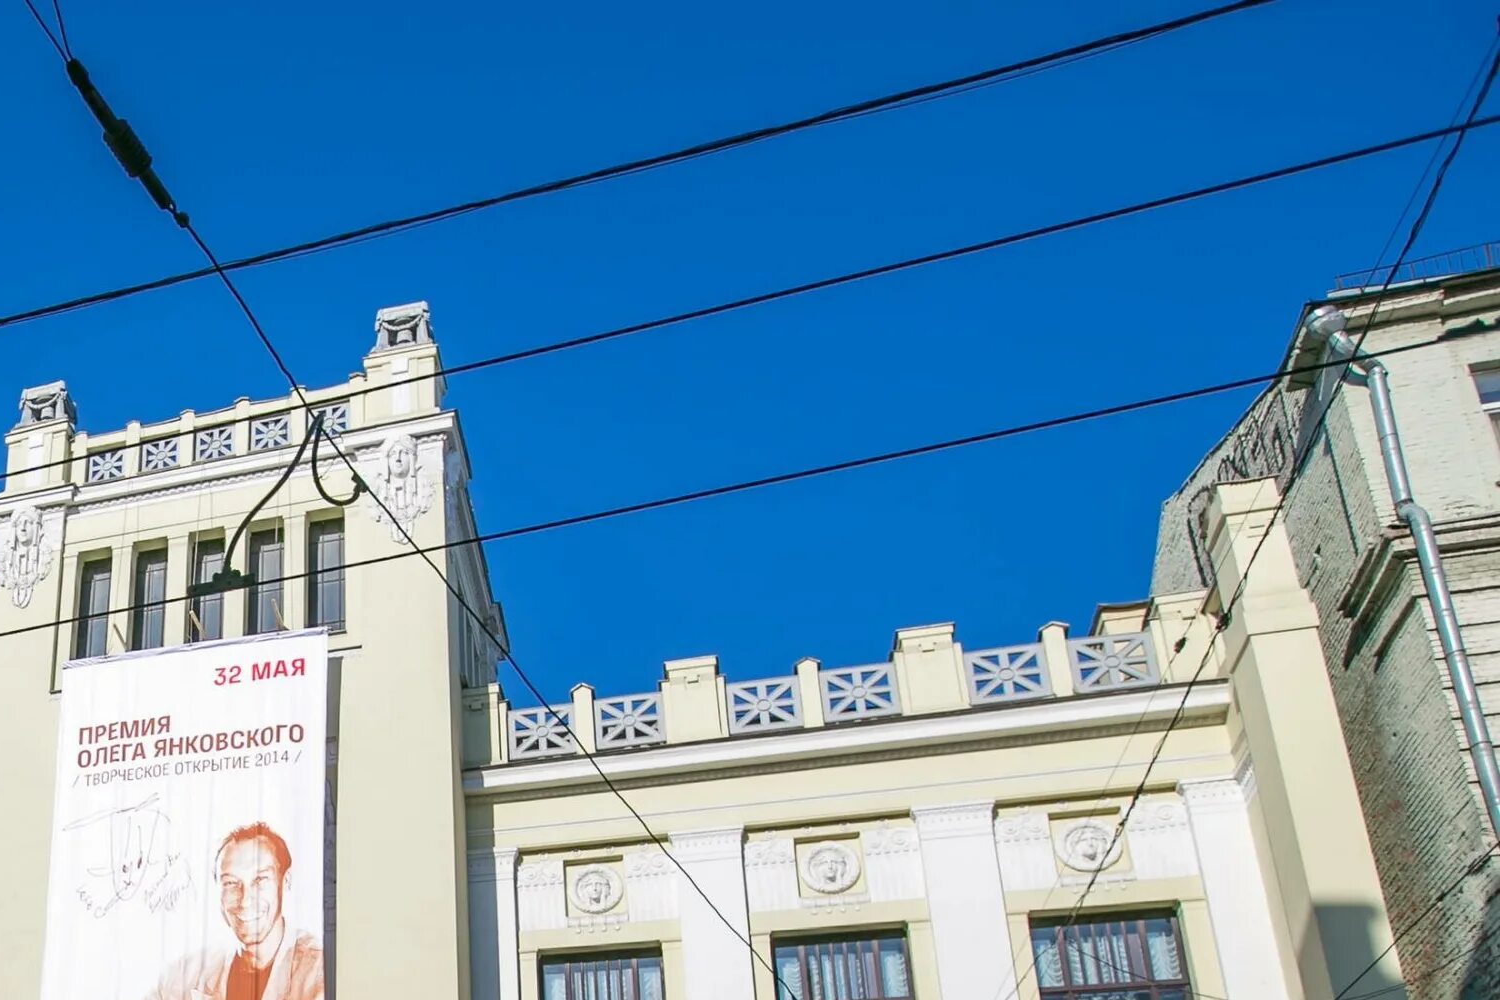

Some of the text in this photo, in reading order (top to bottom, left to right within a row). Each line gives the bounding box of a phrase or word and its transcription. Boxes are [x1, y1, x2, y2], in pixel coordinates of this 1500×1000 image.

[213, 658, 306, 686] 32 МАЯ
[77, 724, 304, 768] ОЛЕГА ЯНКОВСКОГО
[78, 715, 171, 745] ПРЕМИЯ
[85, 763, 169, 787] ТВОРЧЕСКОЕ
[175, 755, 250, 775] ОТКРЫТИЕ
[255, 750, 289, 767] 2014
